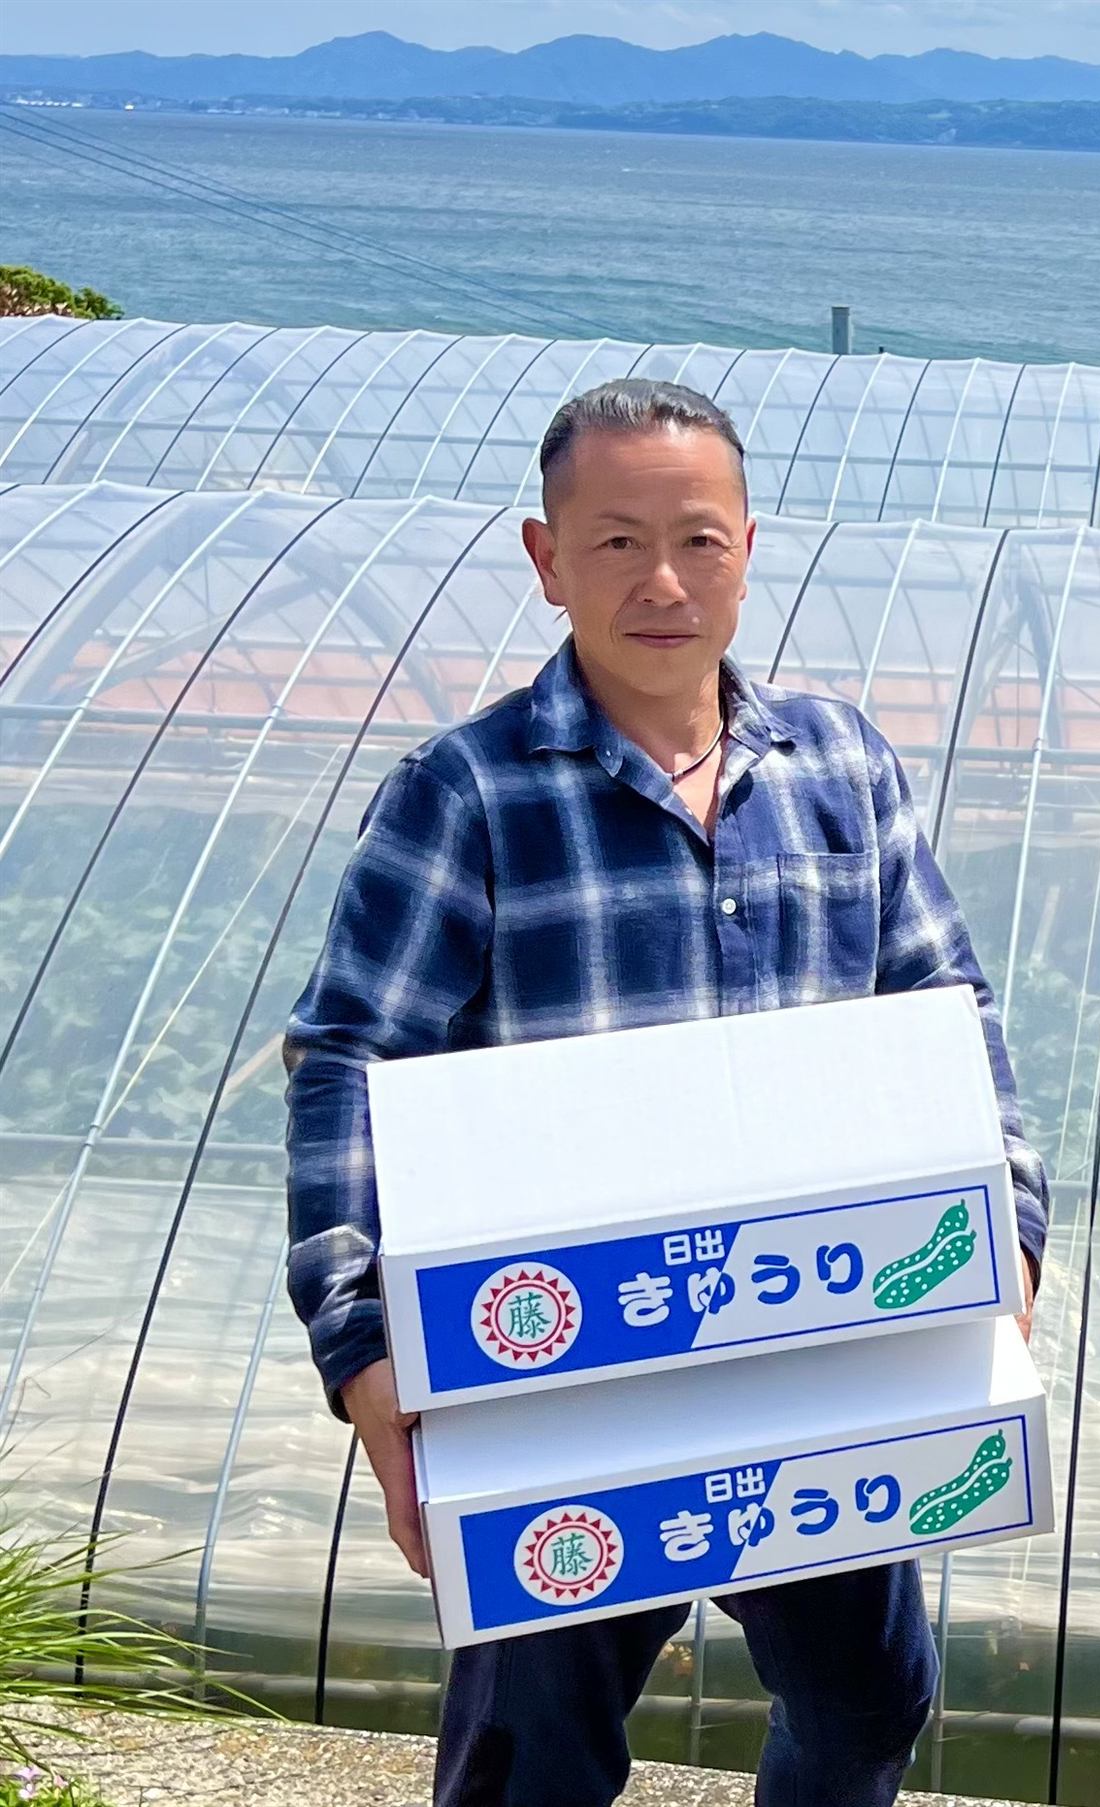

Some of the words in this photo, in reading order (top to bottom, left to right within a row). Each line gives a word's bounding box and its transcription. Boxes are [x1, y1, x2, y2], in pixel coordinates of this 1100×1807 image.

[663, 1231, 725, 1266] 日出
[617, 1242, 863, 1327] きゅうり
[507, 1292, 550, 1340] 藤
[705, 1467, 765, 1502] 日出
[659, 1474, 901, 1561] きゅうり
[550, 1533, 593, 1577] 藤
